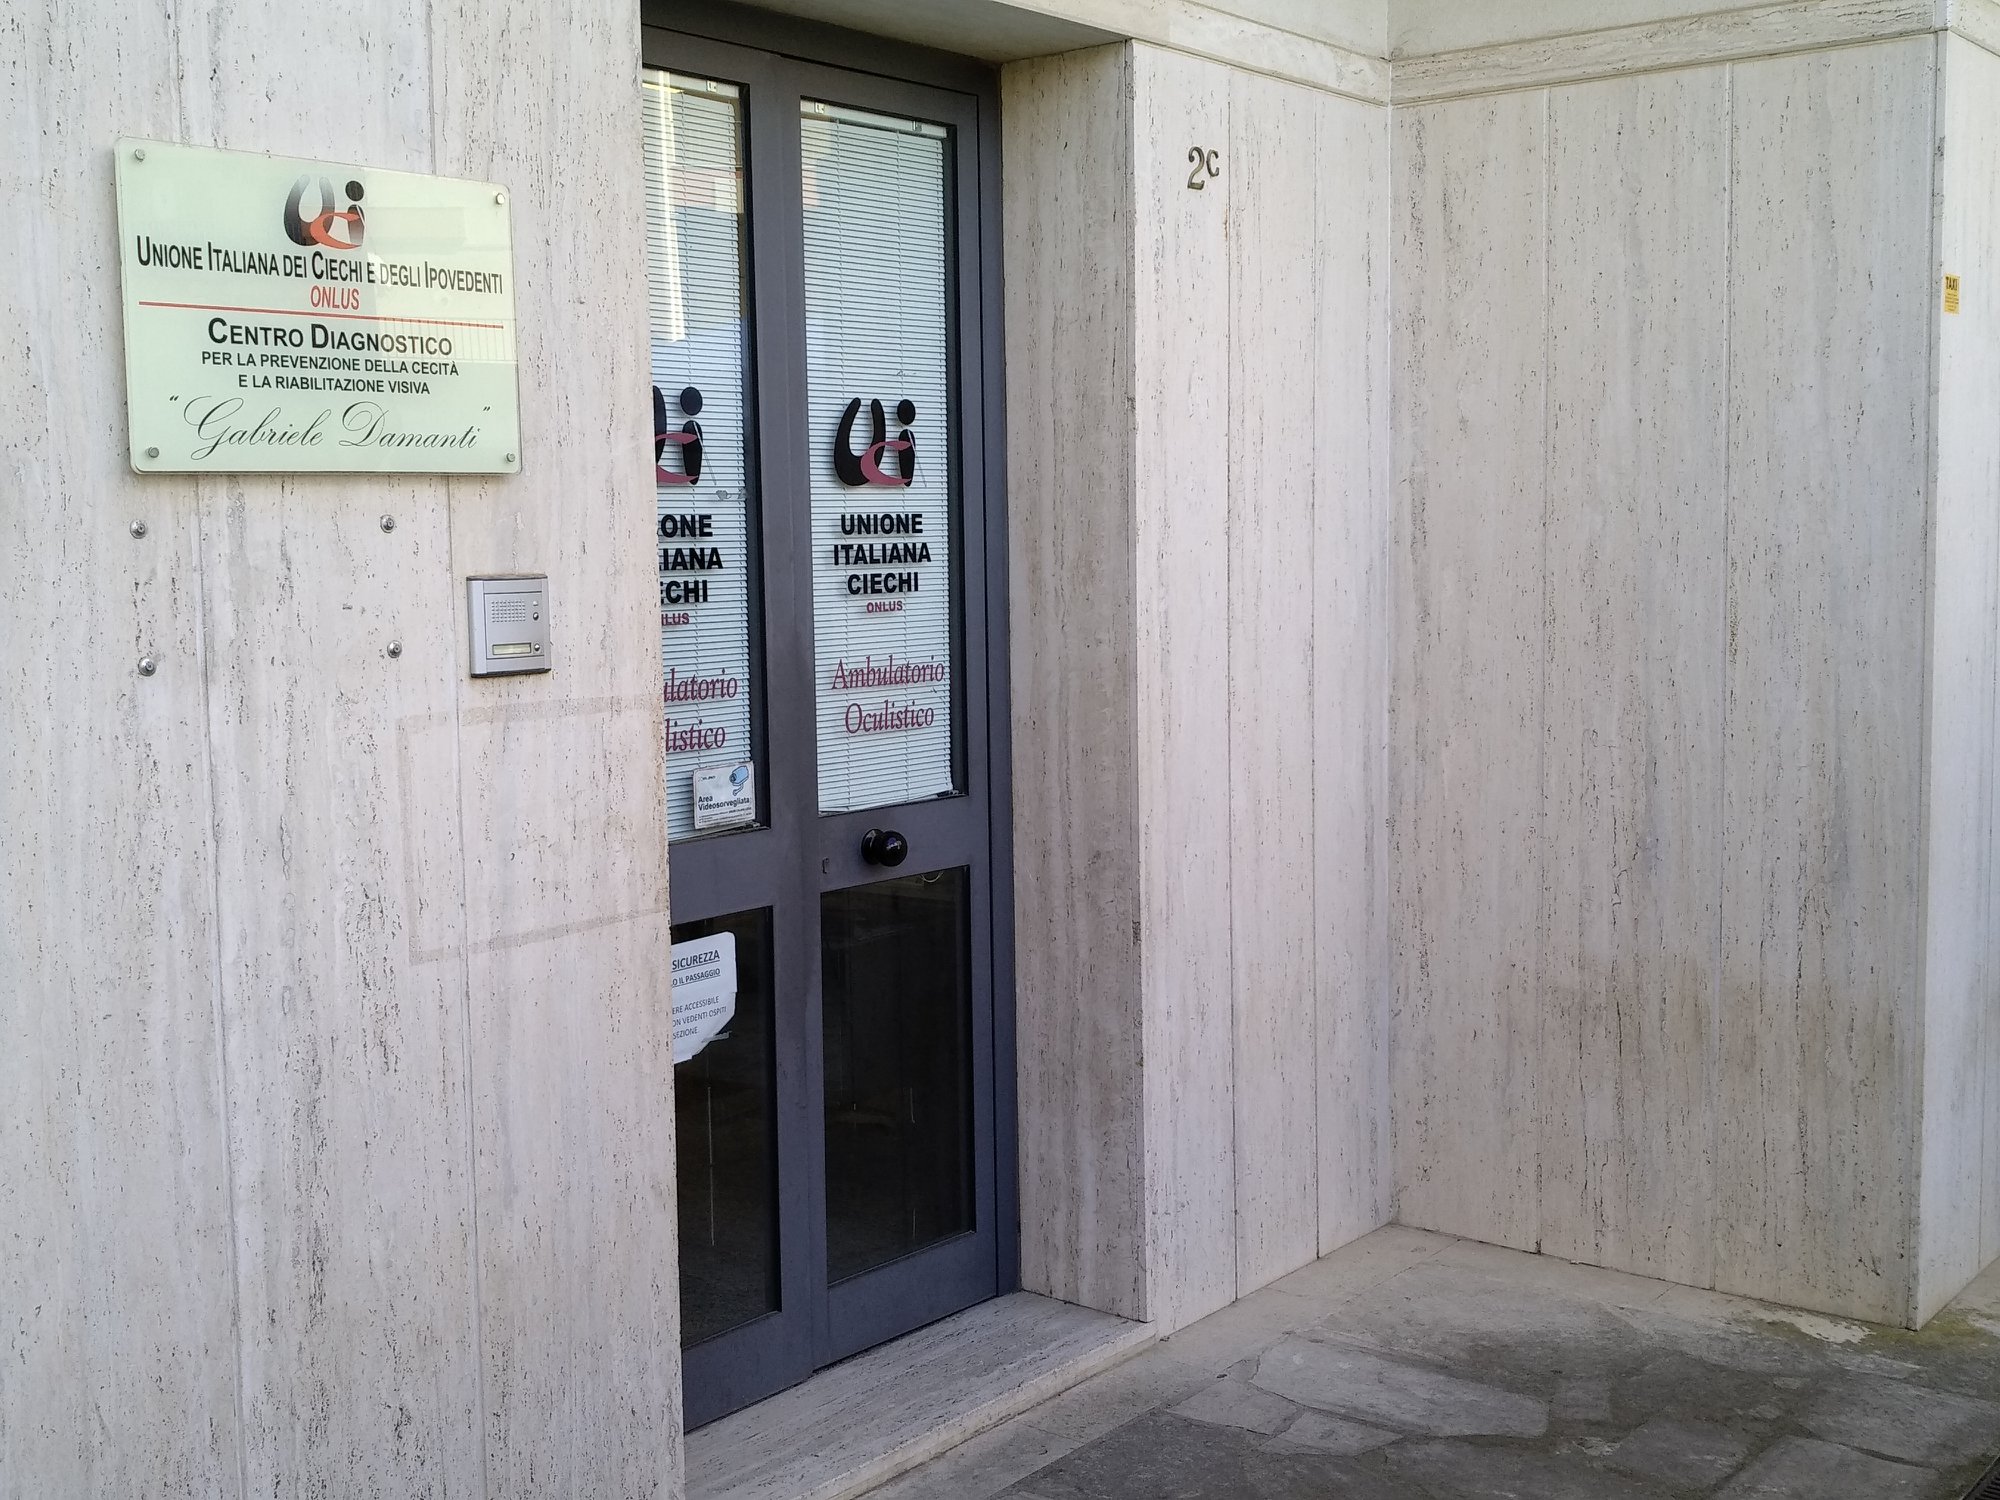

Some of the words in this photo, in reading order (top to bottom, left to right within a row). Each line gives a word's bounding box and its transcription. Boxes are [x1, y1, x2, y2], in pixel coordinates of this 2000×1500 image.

[136, 235, 203, 271] UNIONE
[207, 241, 280, 277] ITALIANA
[282, 254, 308, 279] DEI
[311, 250, 363, 283] CIECHI
[366, 261, 376, 284] E
[379, 262, 421, 288] DEGLI
[424, 261, 503, 295] IPOVEDENTI
[1945, 276, 1958, 290] TAXI
[310, 285, 360, 311] ONLUS
[208, 317, 304, 348] CENTRO
[310, 323, 453, 356] DIAGNOSTICO
[202, 351, 233, 366] PER
[237, 352, 257, 367] LA
[260, 353, 361, 372] PREVENZIONE
[364, 359, 409, 374] DELLA
[411, 360, 460, 377] CECITÀ
[238, 374, 248, 388] E
[252, 375, 272, 389] LA
[275, 375, 385, 393] RIABILITAZIONE
[388, 380, 431, 395] VISIVA
[840, 513, 924, 536] UNIONE
[833, 542, 932, 566] ITALIANA
[847, 571, 919, 595] CIECHI
[866, 600, 903, 614] ONLUS
[831, 653, 945, 690] Ambulatorio
[845, 698, 935, 734] Oculistico
[698, 795, 714, 804] Area
[698, 797, 750, 812] Videosorvegliata
[672, 949, 720, 971] SICUREZZA
[678, 976, 685, 985] IL
[685, 968, 721, 983] PASSAGGIO
[684, 995, 720, 1012] ACCESSIBILE
[681, 1011, 708, 1025] VEDENTI
[708, 1005, 727, 1018] OSPITI
